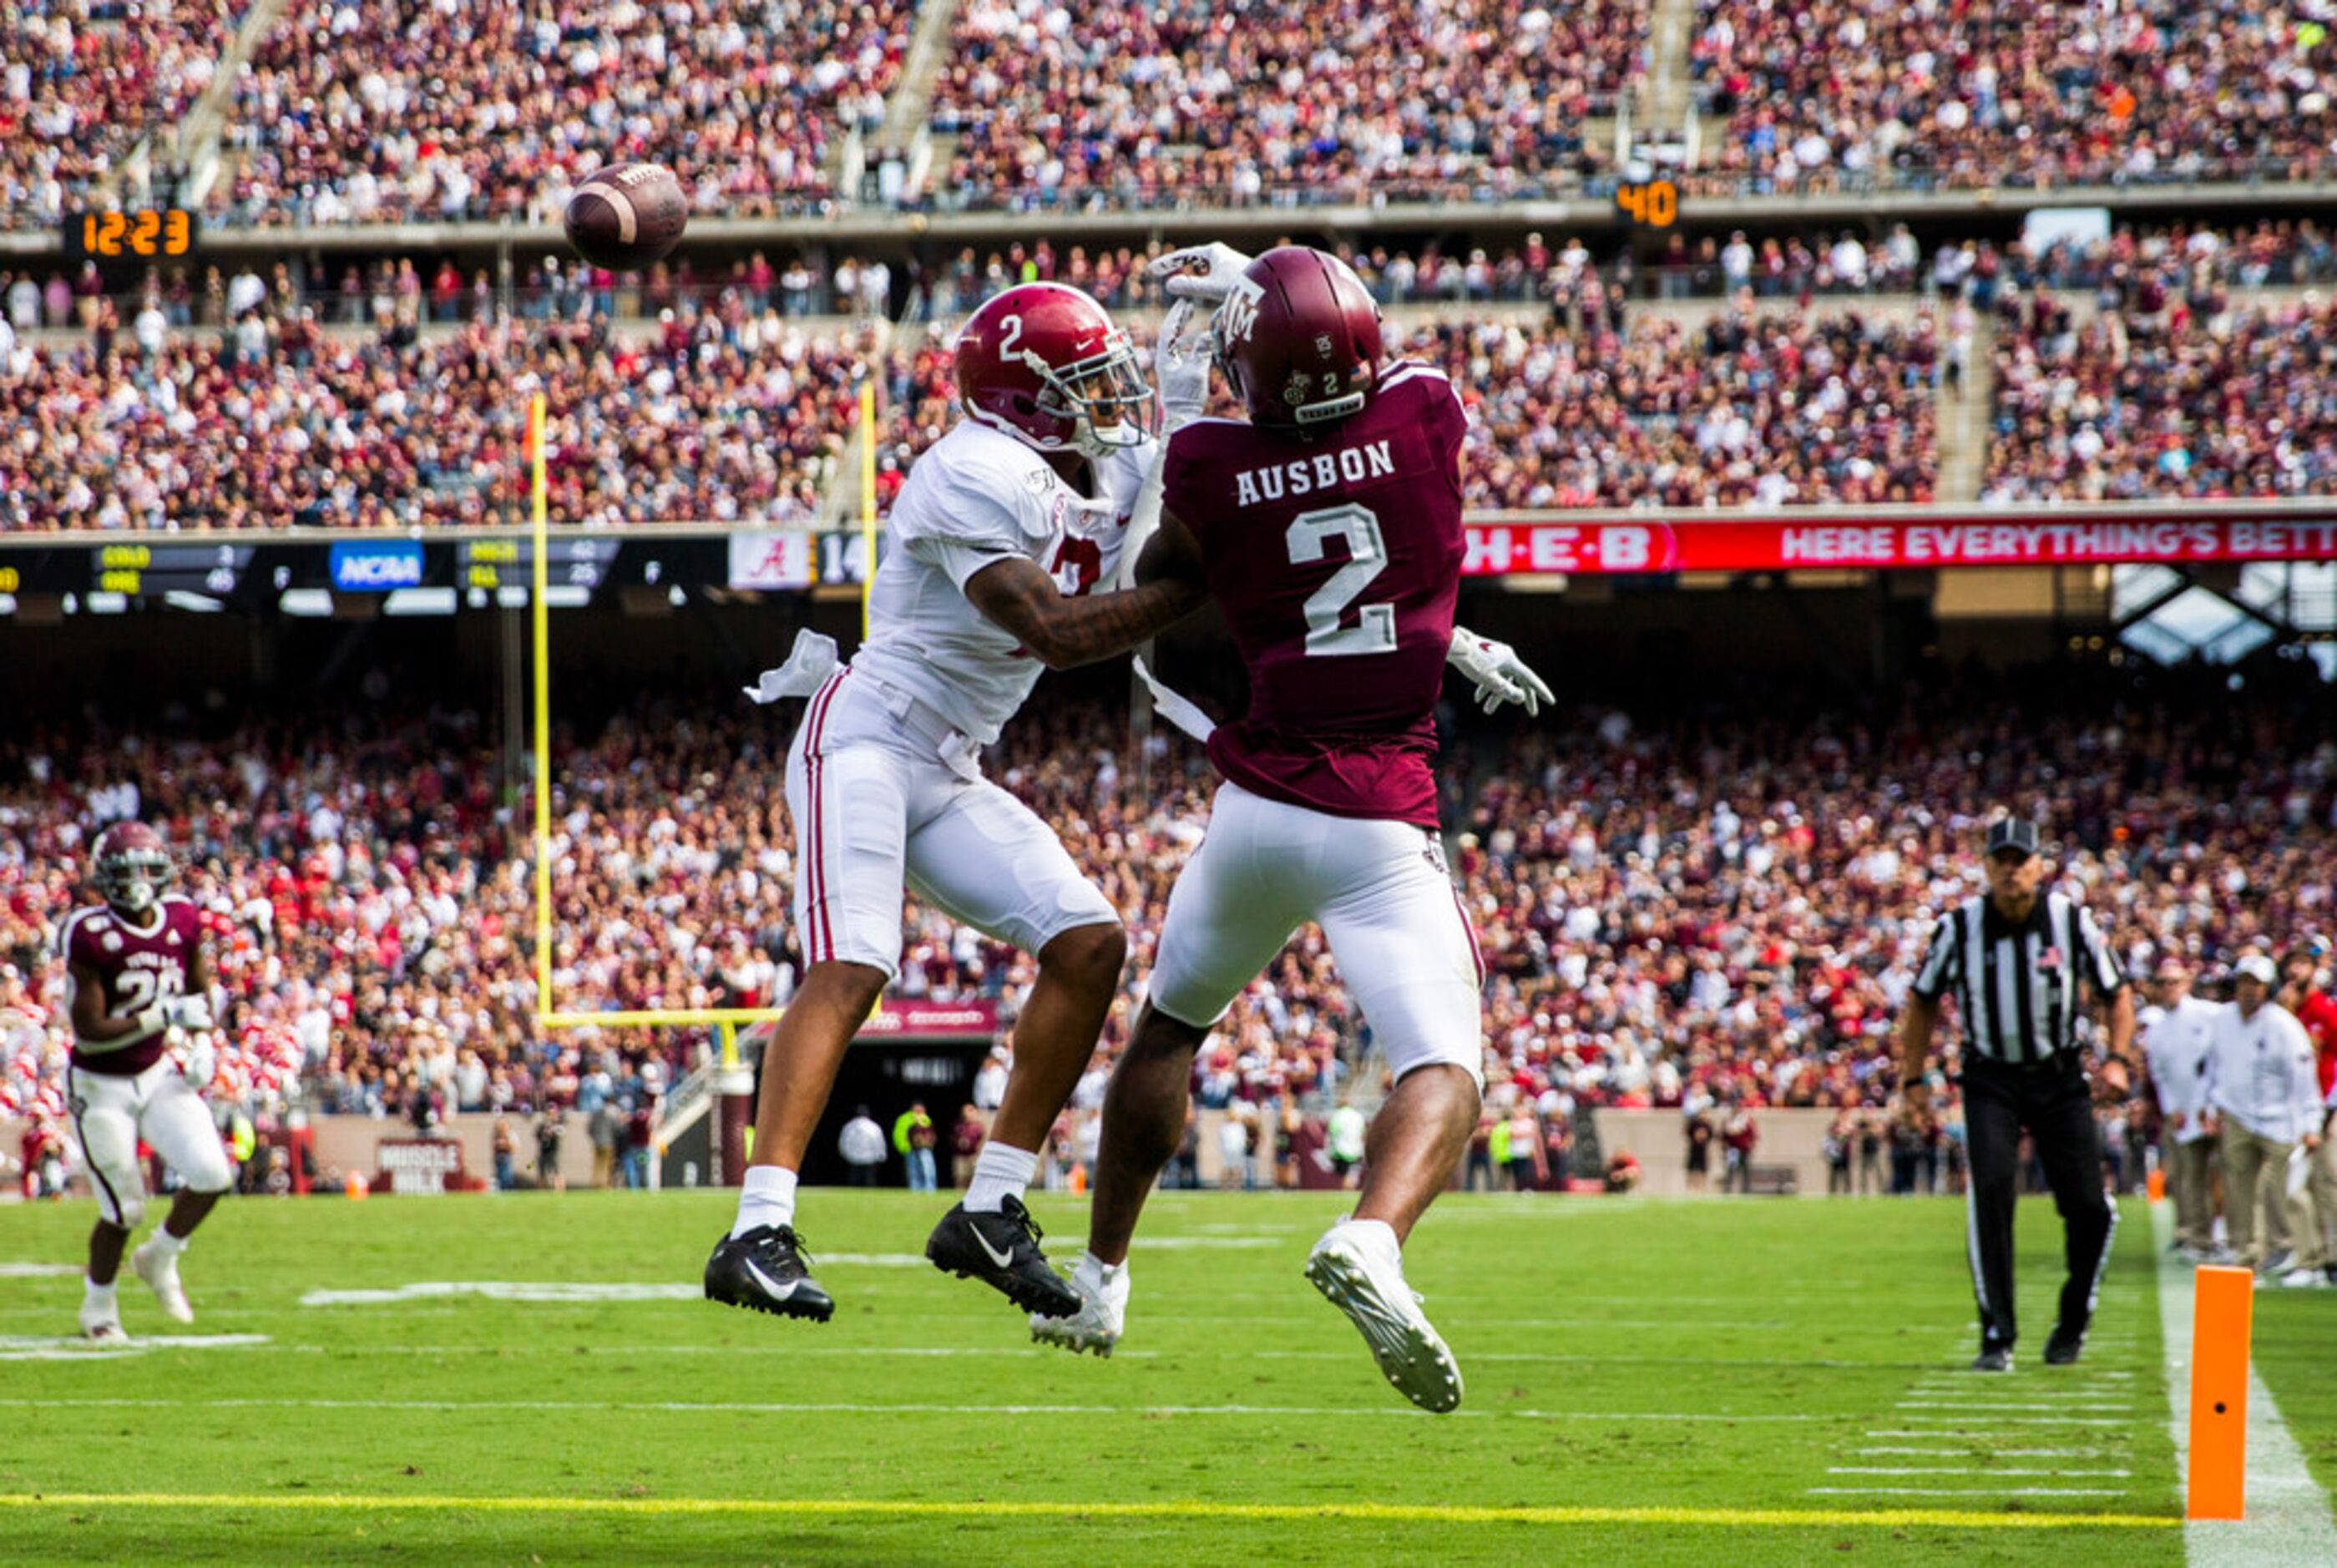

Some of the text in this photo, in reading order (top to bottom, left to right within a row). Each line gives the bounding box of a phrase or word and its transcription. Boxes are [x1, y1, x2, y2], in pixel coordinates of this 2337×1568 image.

[1616, 180, 1677, 226] 40
[83, 209, 190, 255] 12:23
[999, 314, 1023, 362] 2
[1323, 372, 1338, 396] 2
[1236, 440, 1395, 507] AUSBON
[1780, 518, 2337, 561] HERE EVERYTHING'S BETT
[338, 556, 420, 584] NCAA
[1286, 501, 1399, 655] 2
